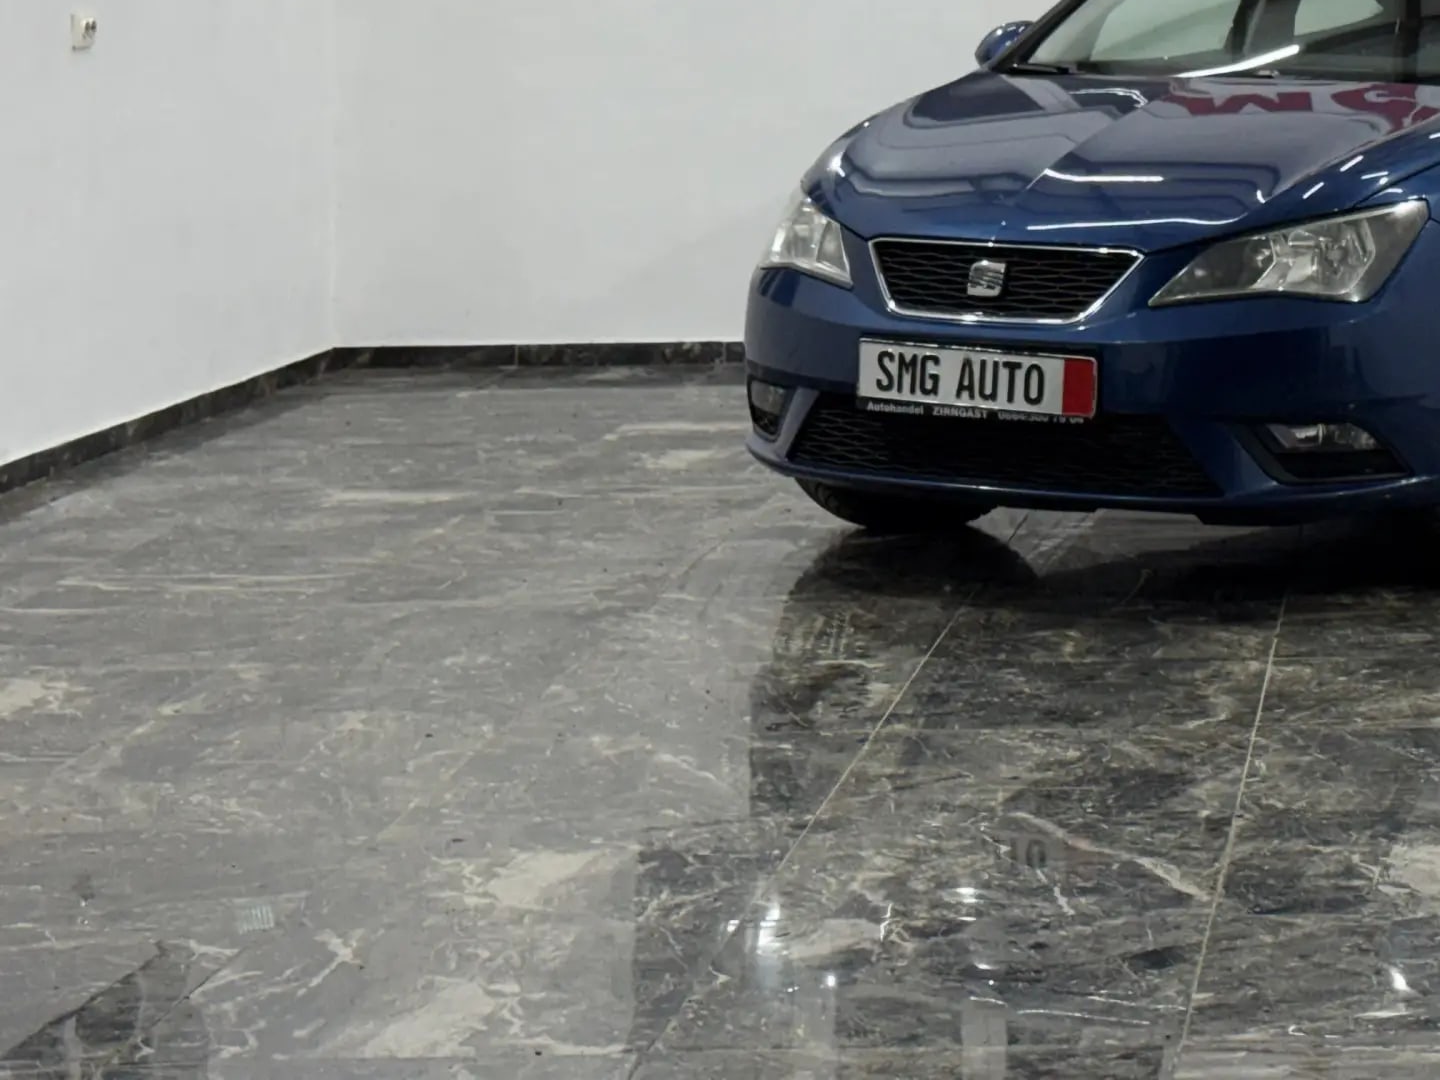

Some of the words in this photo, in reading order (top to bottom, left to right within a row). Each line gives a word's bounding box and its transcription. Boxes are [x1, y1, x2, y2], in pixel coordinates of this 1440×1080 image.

[875, 350, 941, 397] SMG
[955, 356, 1046, 407] AUTO
[867, 401, 924, 415] Autohandel
